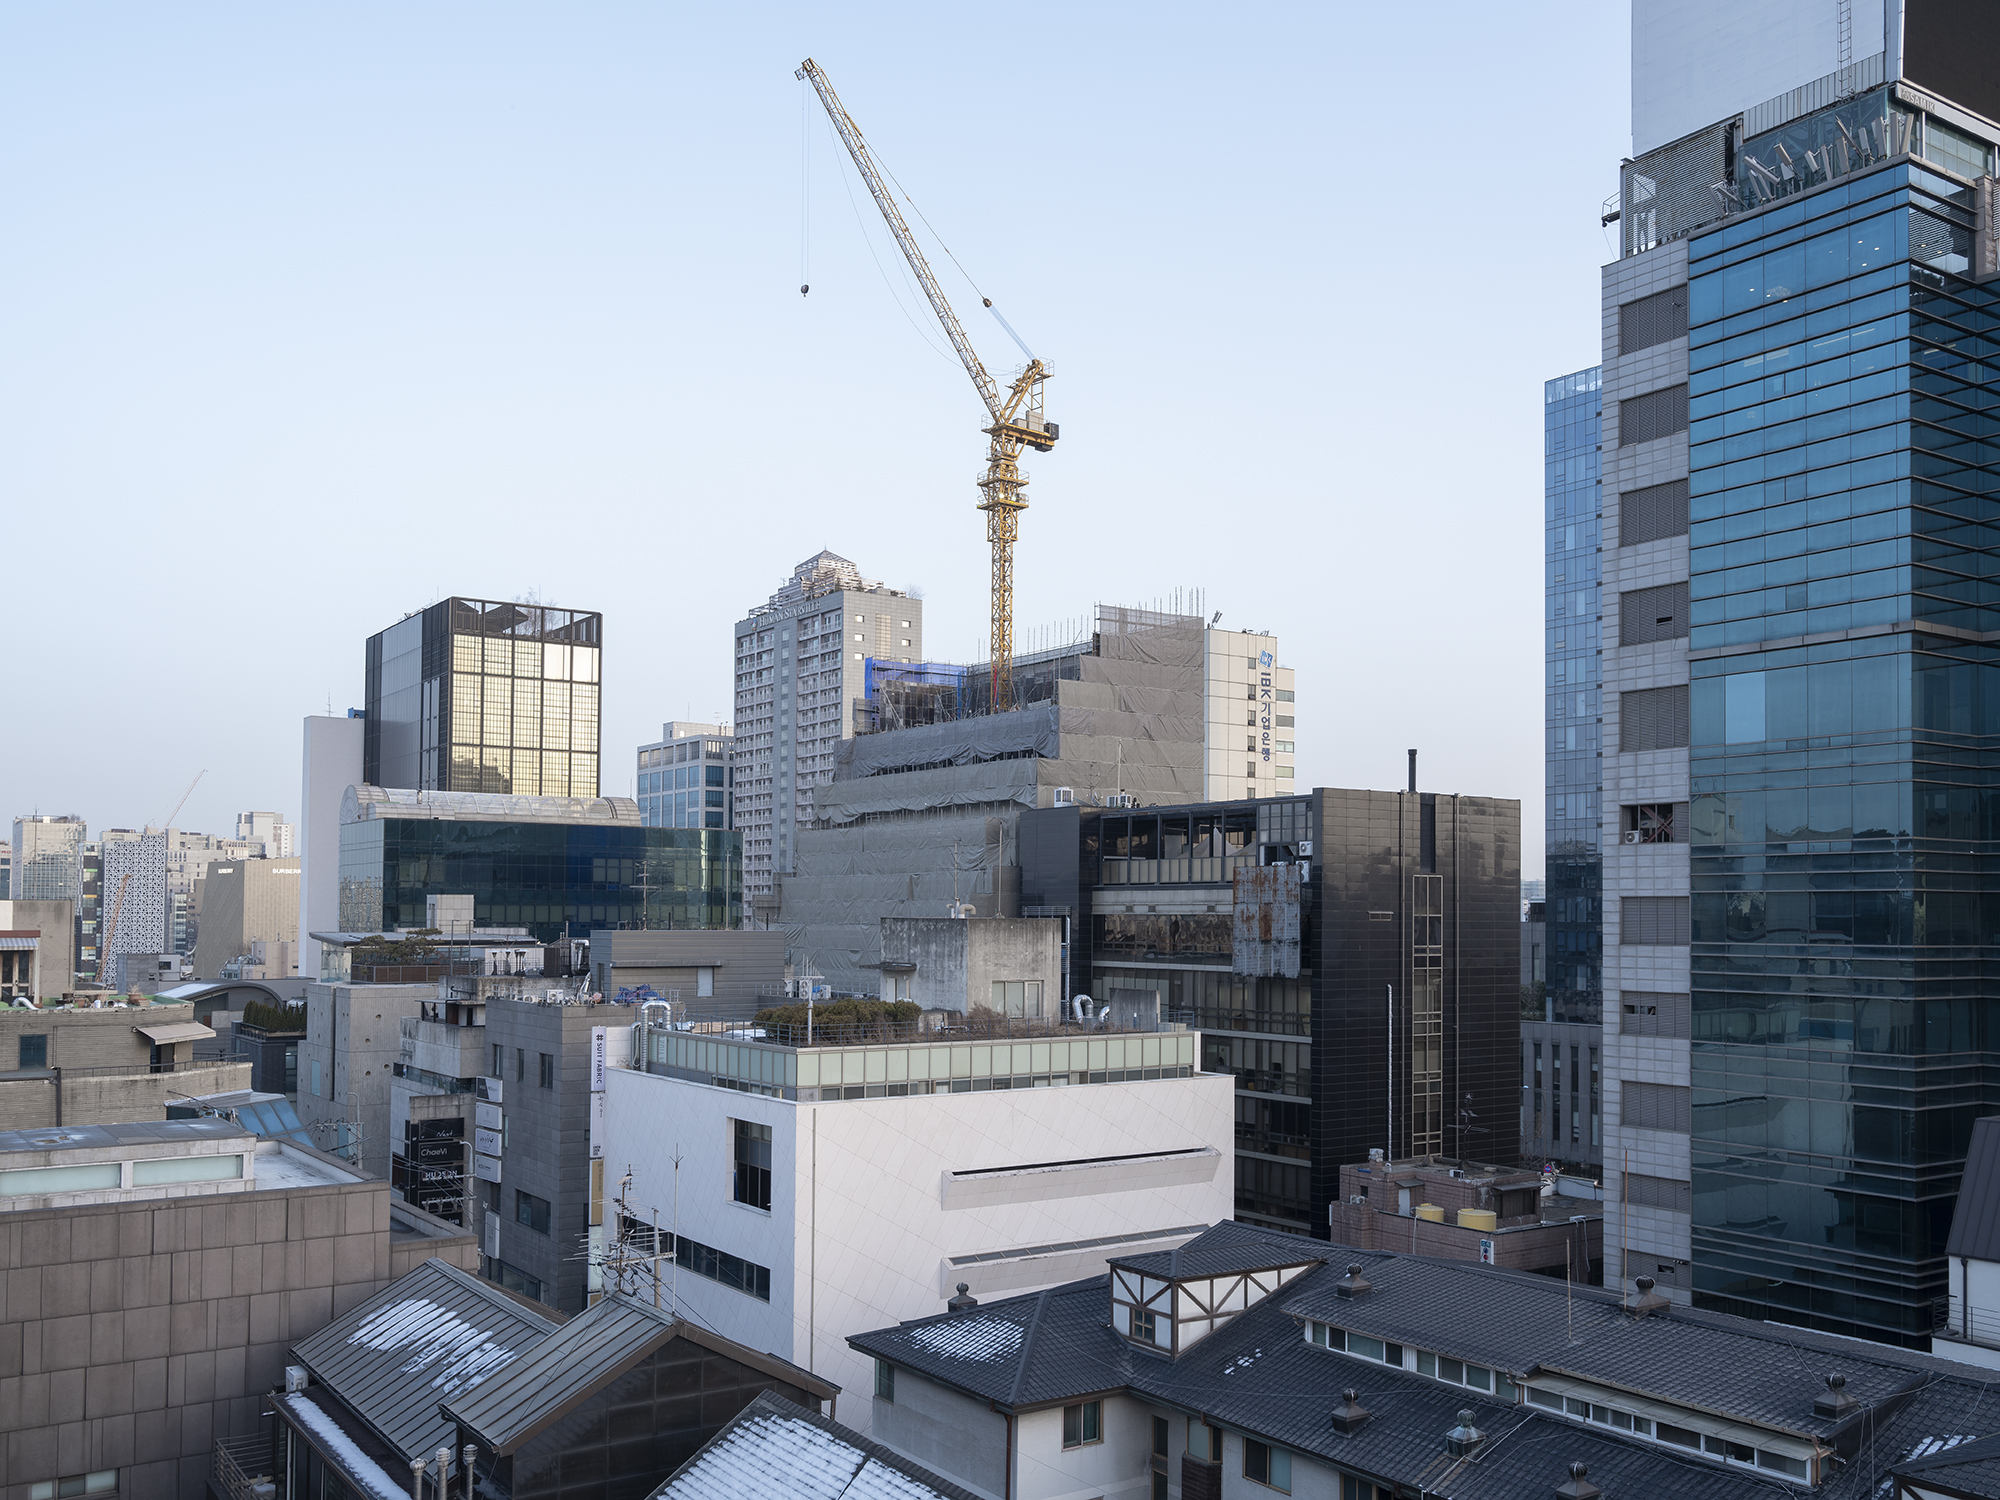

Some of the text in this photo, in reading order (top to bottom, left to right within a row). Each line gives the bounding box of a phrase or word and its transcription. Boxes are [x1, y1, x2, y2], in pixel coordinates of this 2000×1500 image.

[1910, 93, 1935, 113] SAMIK
[760, 612, 784, 627] HUMAN
[1260, 672, 1272, 762] IBK 기업은행
